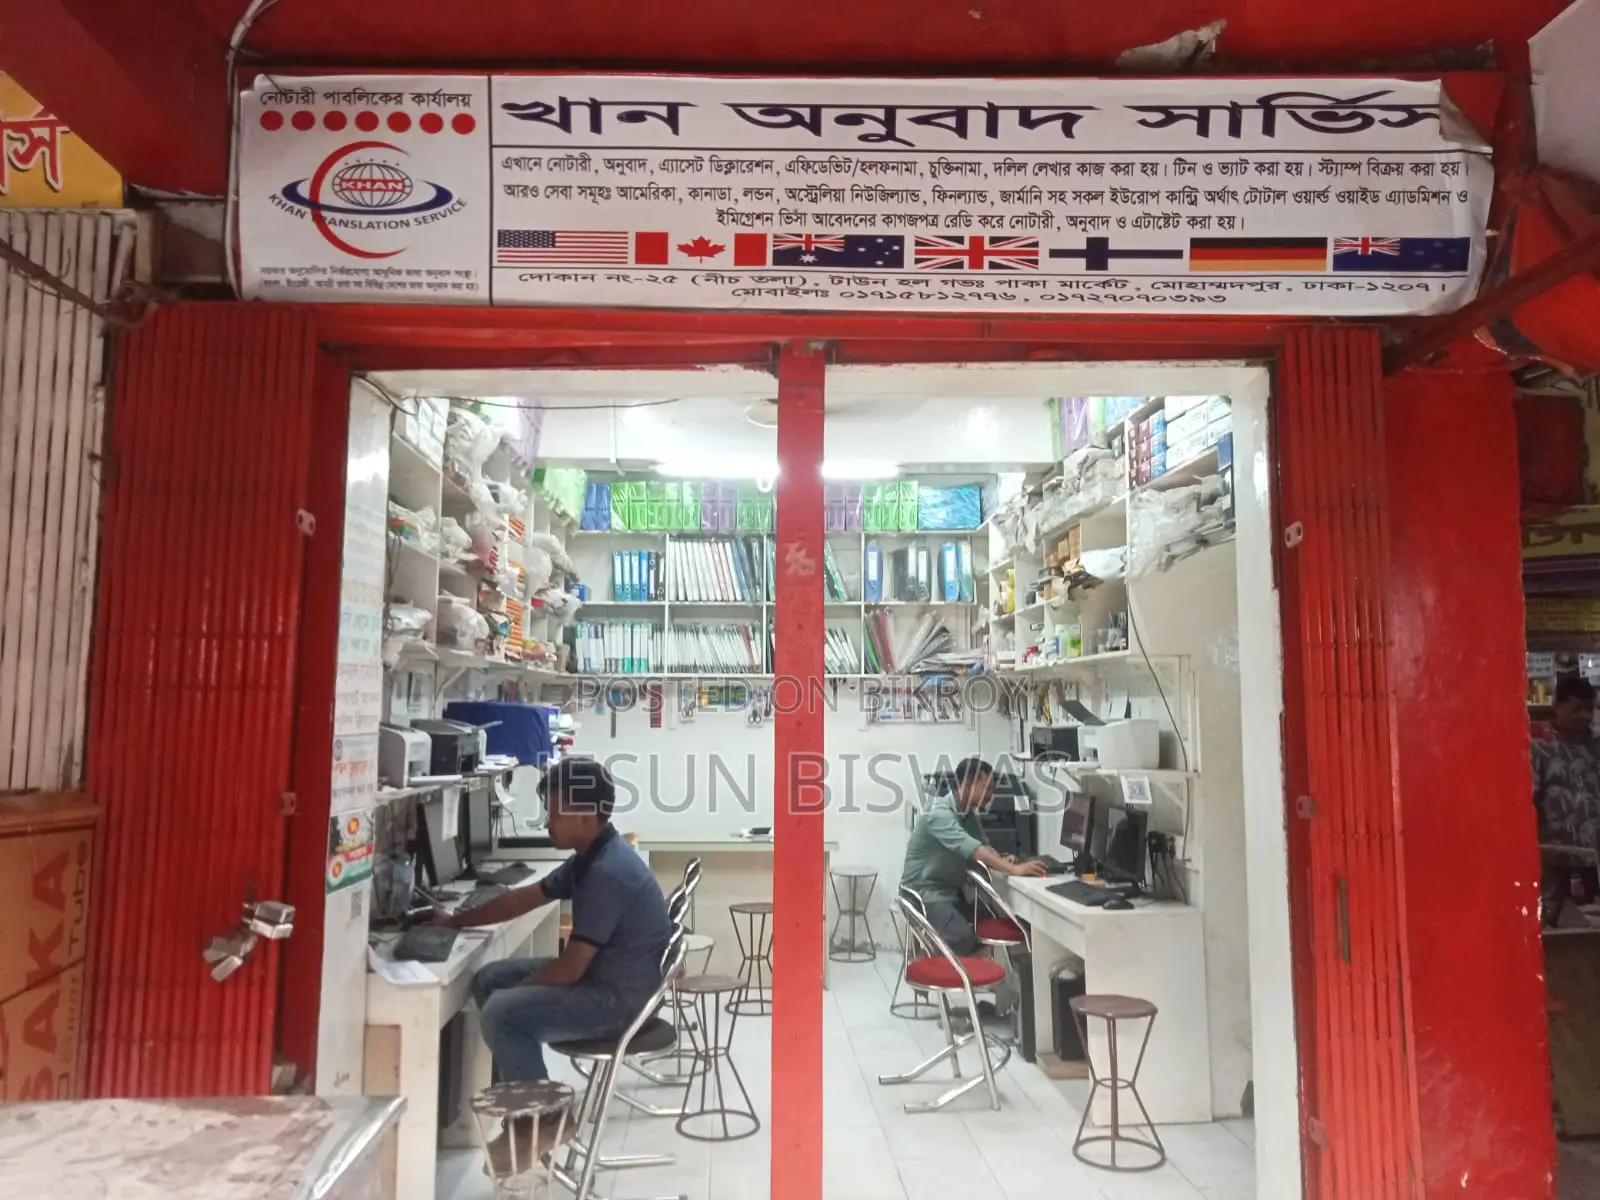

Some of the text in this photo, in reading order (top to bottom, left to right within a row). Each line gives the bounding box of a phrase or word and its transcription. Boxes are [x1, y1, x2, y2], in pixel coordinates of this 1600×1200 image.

[260, 87, 316, 106] নোটারী
[323, 87, 404, 107] পাবলিকের
[500, 95, 700, 137] খান
[720, 100, 1103, 147] অনুবাদ
[501, 156, 543, 173] এখানে
[993, 157, 1028, 177] দলিল
[1032, 160, 1072, 177] লেখার
[1076, 160, 1106, 177] কাজ
[1109, 162, 1136, 177] করা
[1172, 157, 1198, 177] টিন
[1202, 163, 1213, 177] ও
[1218, 157, 1249, 177] ভ্যাট
[1254, 161, 1280, 177] করা
[1367, 157, 1404, 177] বিক্রয়
[1410, 161, 1437, 177] করা
[341, 181, 404, 191] KHAN
[503, 184, 539, 200] আরও
[544, 184, 572, 200] সেবা
[999, 185, 1044, 205] জার্মানি
[1048, 190, 1068, 205] সহ
[1072, 190, 1105, 205] সকল
[1109, 186, 1161, 206] ইউরোপ
[1243, 185, 1288, 206] টোটাল
[1336, 187, 1381, 206] ওয়াইড
[1457, 190, 1468, 204] ও
[268, 193, 307, 220] KHAN
[414, 197, 468, 227] SERVICE
[716, 207, 774, 227] ইমিগ্রেশন
[812, 212, 877, 228] আবেদনের
[882, 213, 940, 229] কাগজপত্র
[944, 209, 973, 229] রেডি
[978, 213, 1006, 229] করে
[1065, 214, 1112, 232] অনুবাদ
[1116, 217, 1127, 230] ও
[1186, 215, 1213, 230] করা
[518, 272, 596, 284] দোকান
[828, 274, 889, 288] টাউন
[897, 278, 932, 289] হল
[995, 279, 1050, 291] পাকা
